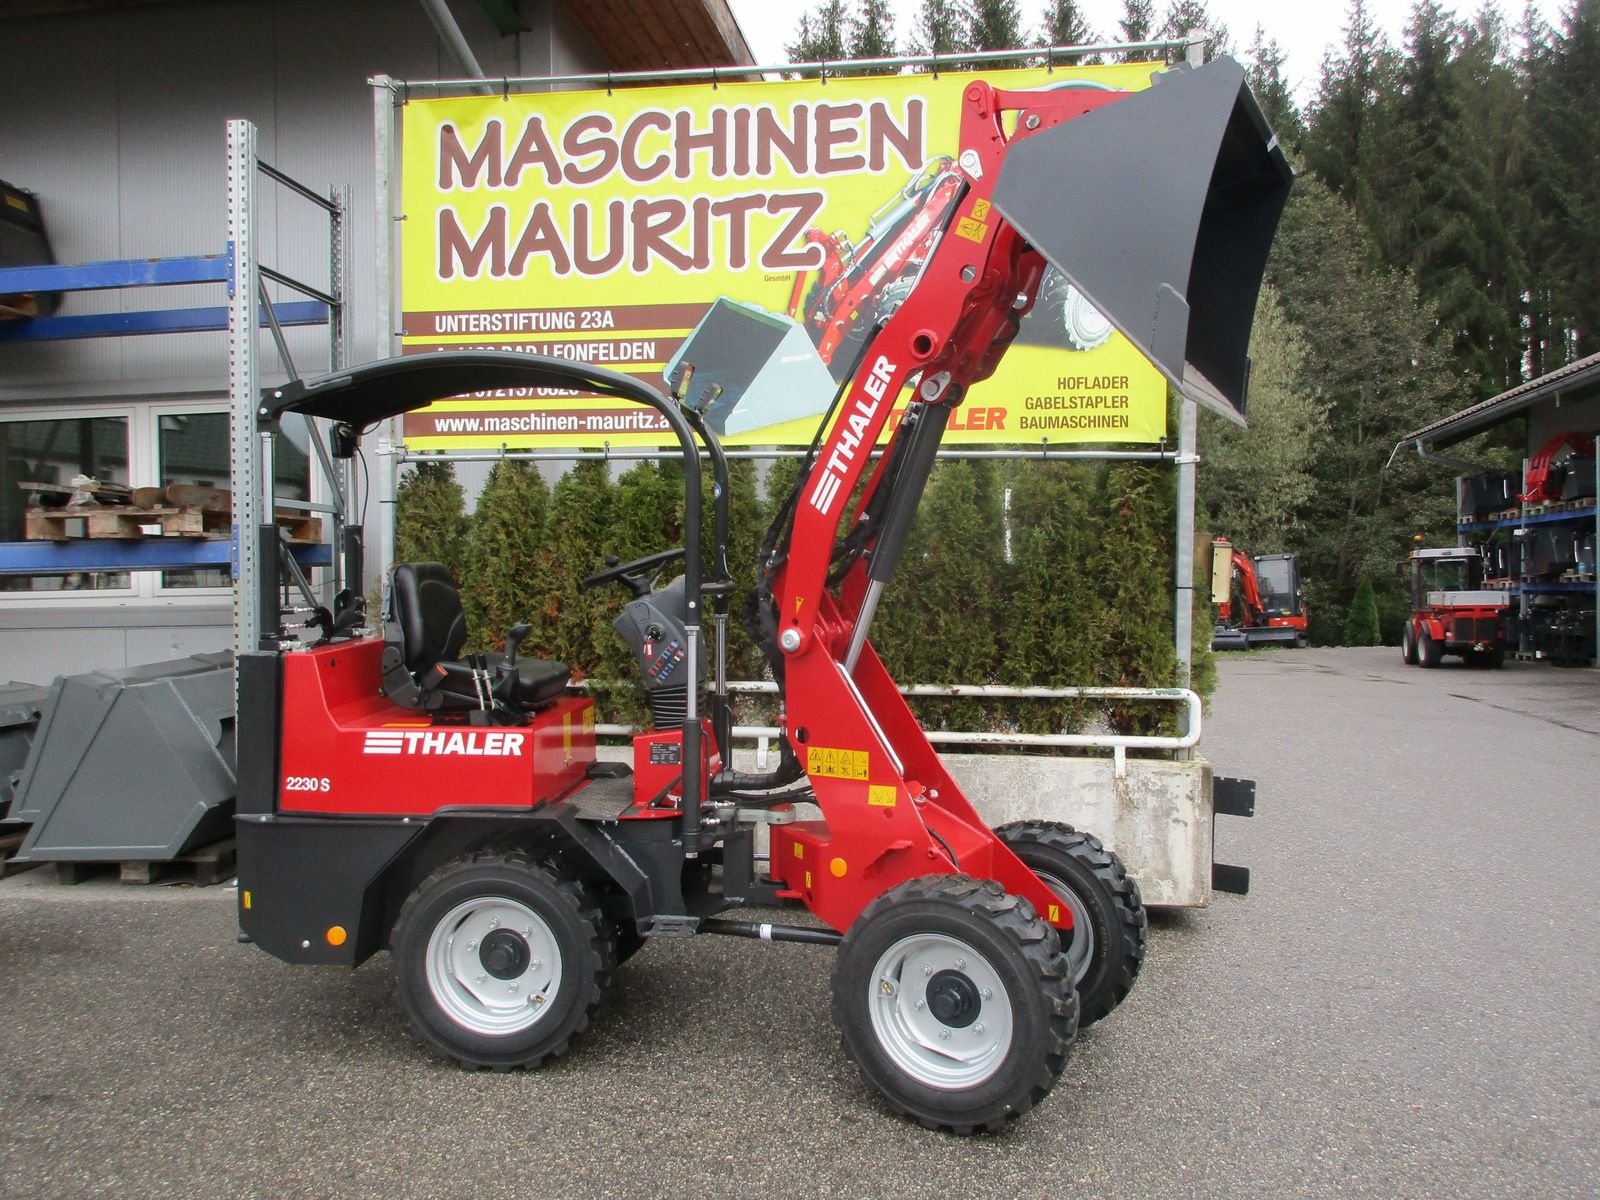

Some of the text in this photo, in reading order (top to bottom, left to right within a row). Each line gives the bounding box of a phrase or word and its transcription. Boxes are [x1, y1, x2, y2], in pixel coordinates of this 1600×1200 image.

[440, 99, 925, 190] MASCHINEN
[438, 192, 825, 279] MAURITZ
[434, 310, 615, 333] UNTERSTIFTUNG 23A
[1057, 376, 1129, 390] HOFLADER
[1025, 396, 1129, 410] GABELSTAPLER
[434, 411, 670, 432] www.maschinen-mauritz.a
[826, 355, 897, 474] THALER
[1019, 415, 1129, 430] BAUMASCHINEN
[403, 732, 525, 756] THALER
[286, 776, 331, 792] 2230 S
